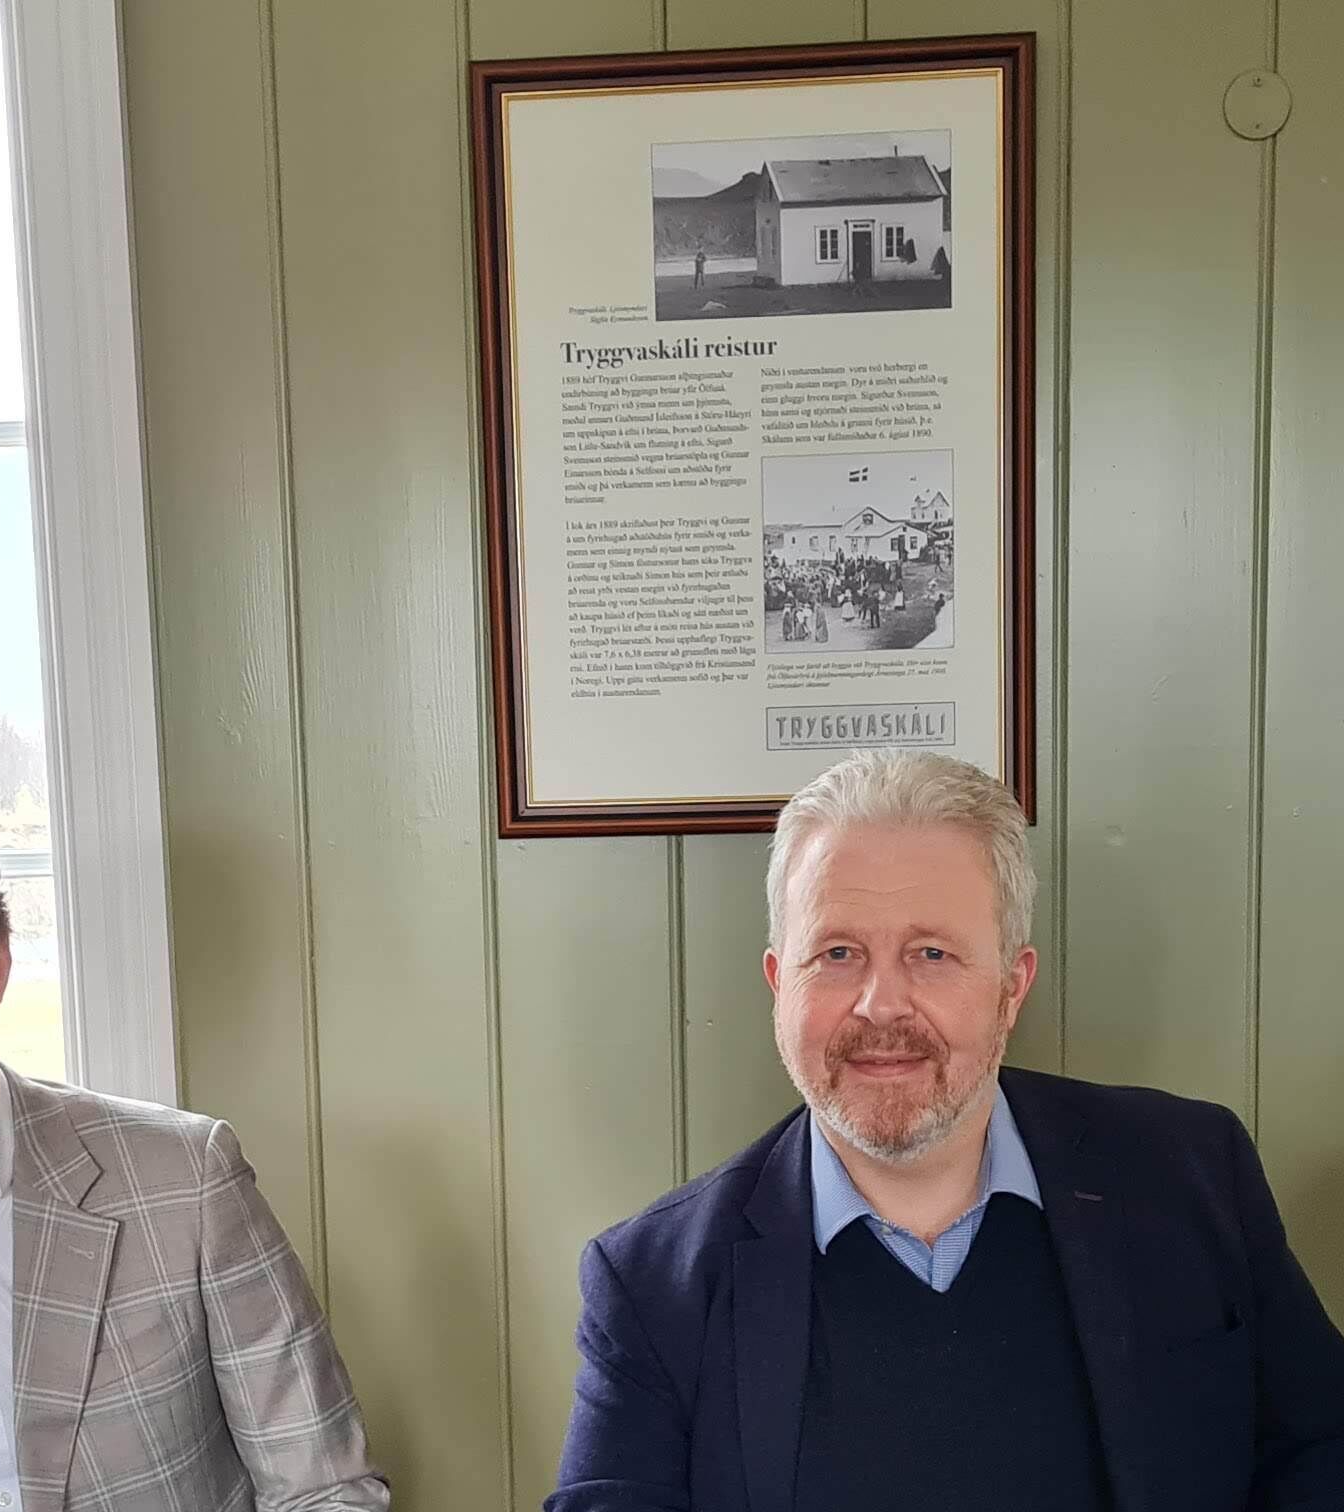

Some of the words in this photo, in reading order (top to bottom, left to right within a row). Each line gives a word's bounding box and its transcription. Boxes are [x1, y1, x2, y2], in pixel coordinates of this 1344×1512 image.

[561, 338, 698, 369] Tryggvaskáli
[704, 335, 777, 358] reistur
[776, 705, 945, 739] TRYGGVASKÁLI
